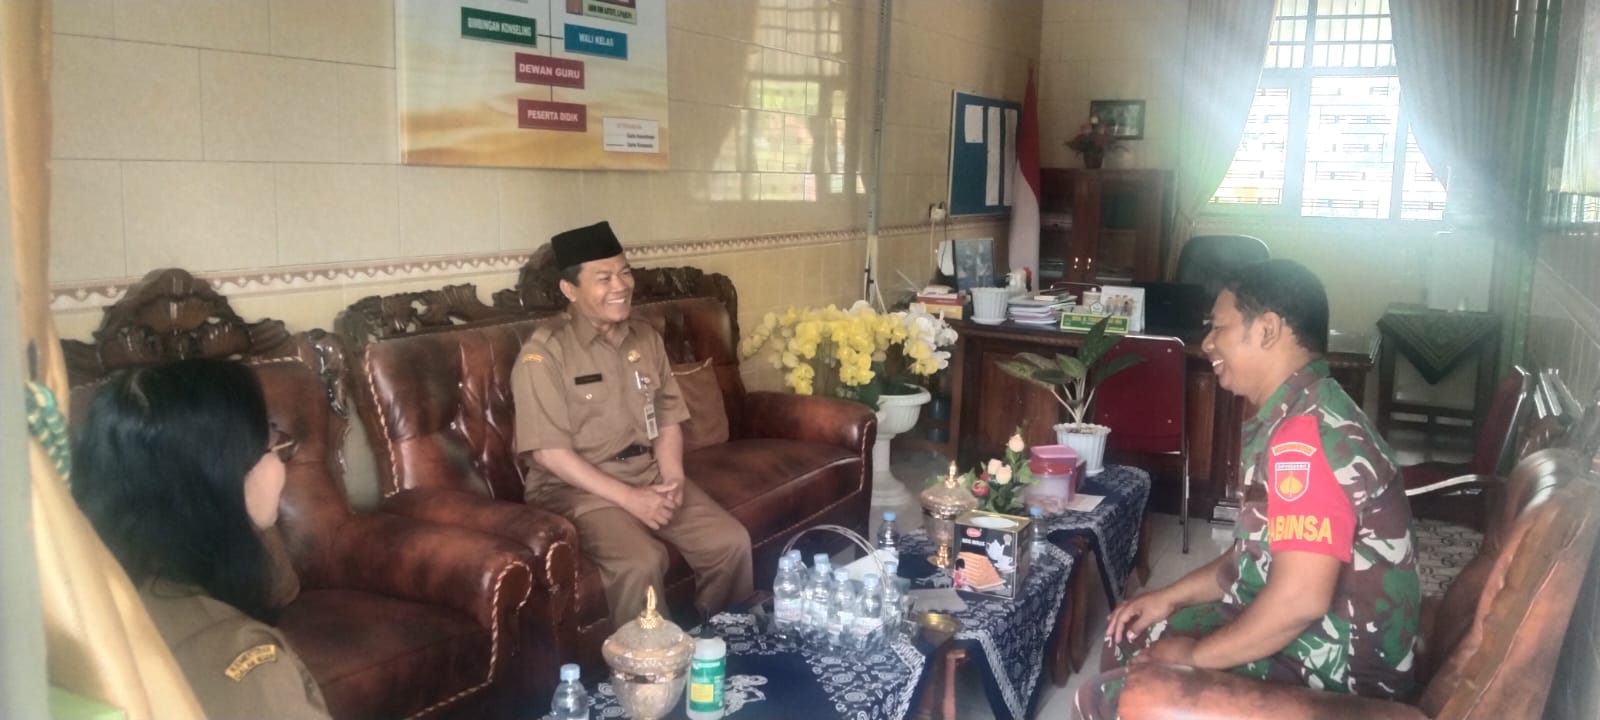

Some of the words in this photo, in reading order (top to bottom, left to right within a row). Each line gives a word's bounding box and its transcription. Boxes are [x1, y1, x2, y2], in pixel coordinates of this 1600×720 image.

[501, 22, 532, 37] KONSELING
[579, 32, 594, 44] WALI
[595, 35, 614, 47] KELAS
[519, 63, 553, 76] DEWAN
[555, 67, 580, 79] GURU
[527, 109, 559, 121] PESERTA
[559, 112, 579, 122] DIDIK
